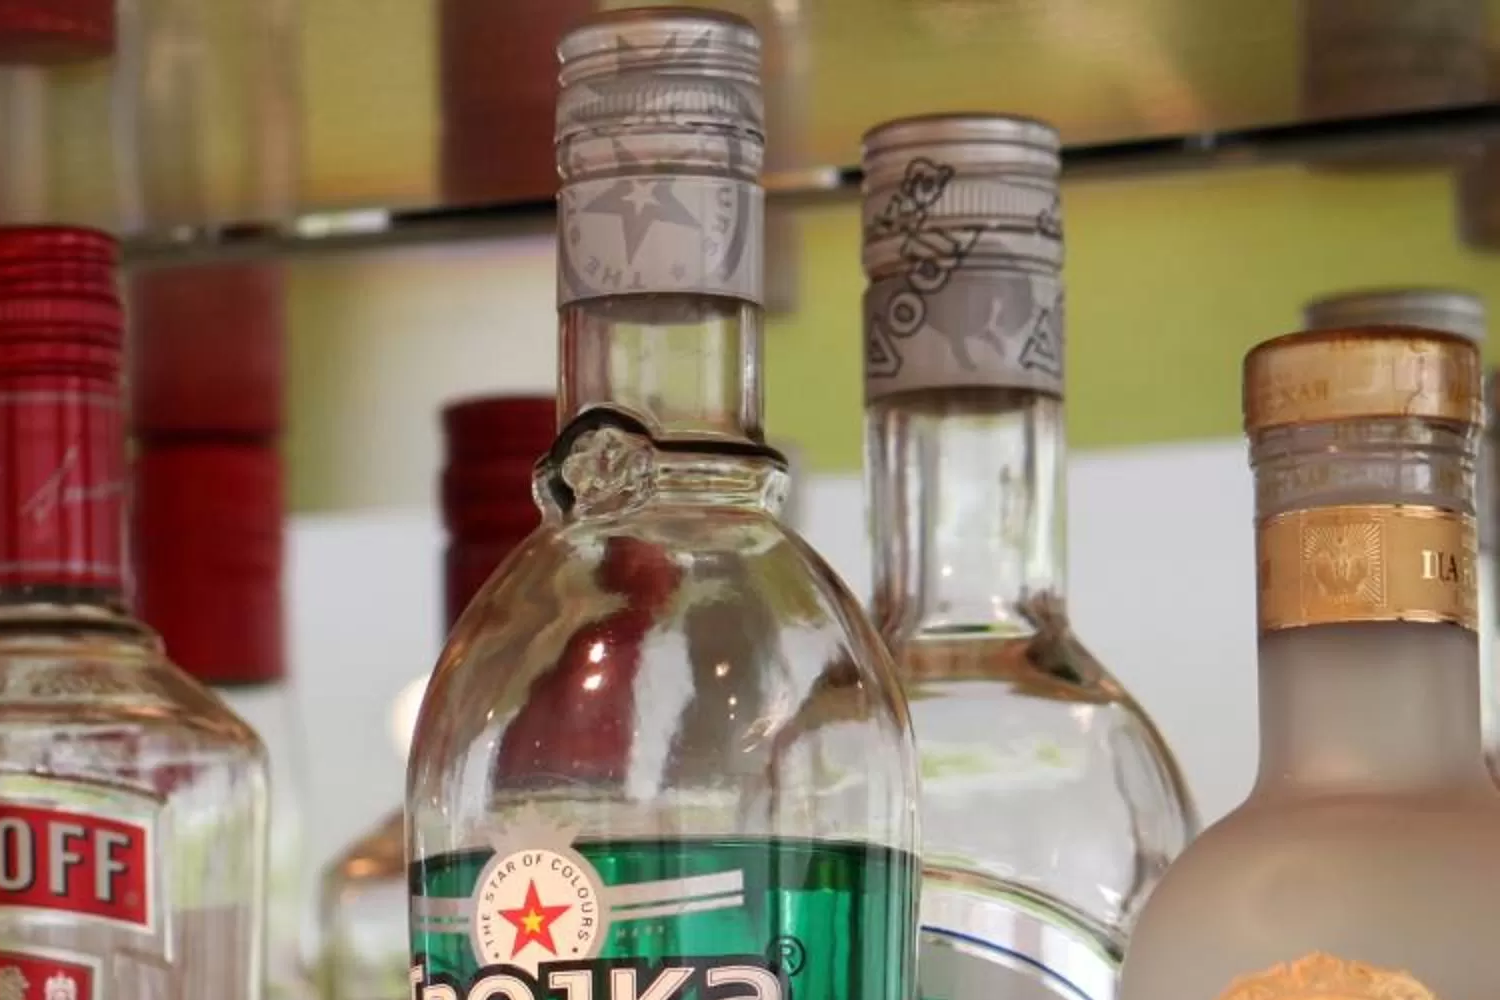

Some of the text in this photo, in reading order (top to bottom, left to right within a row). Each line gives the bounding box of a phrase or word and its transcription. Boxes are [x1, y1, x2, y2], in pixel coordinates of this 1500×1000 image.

[485, 861, 517, 902] STAR
[522, 853, 543, 867] OF
[551, 858, 593, 941] COLOURS
